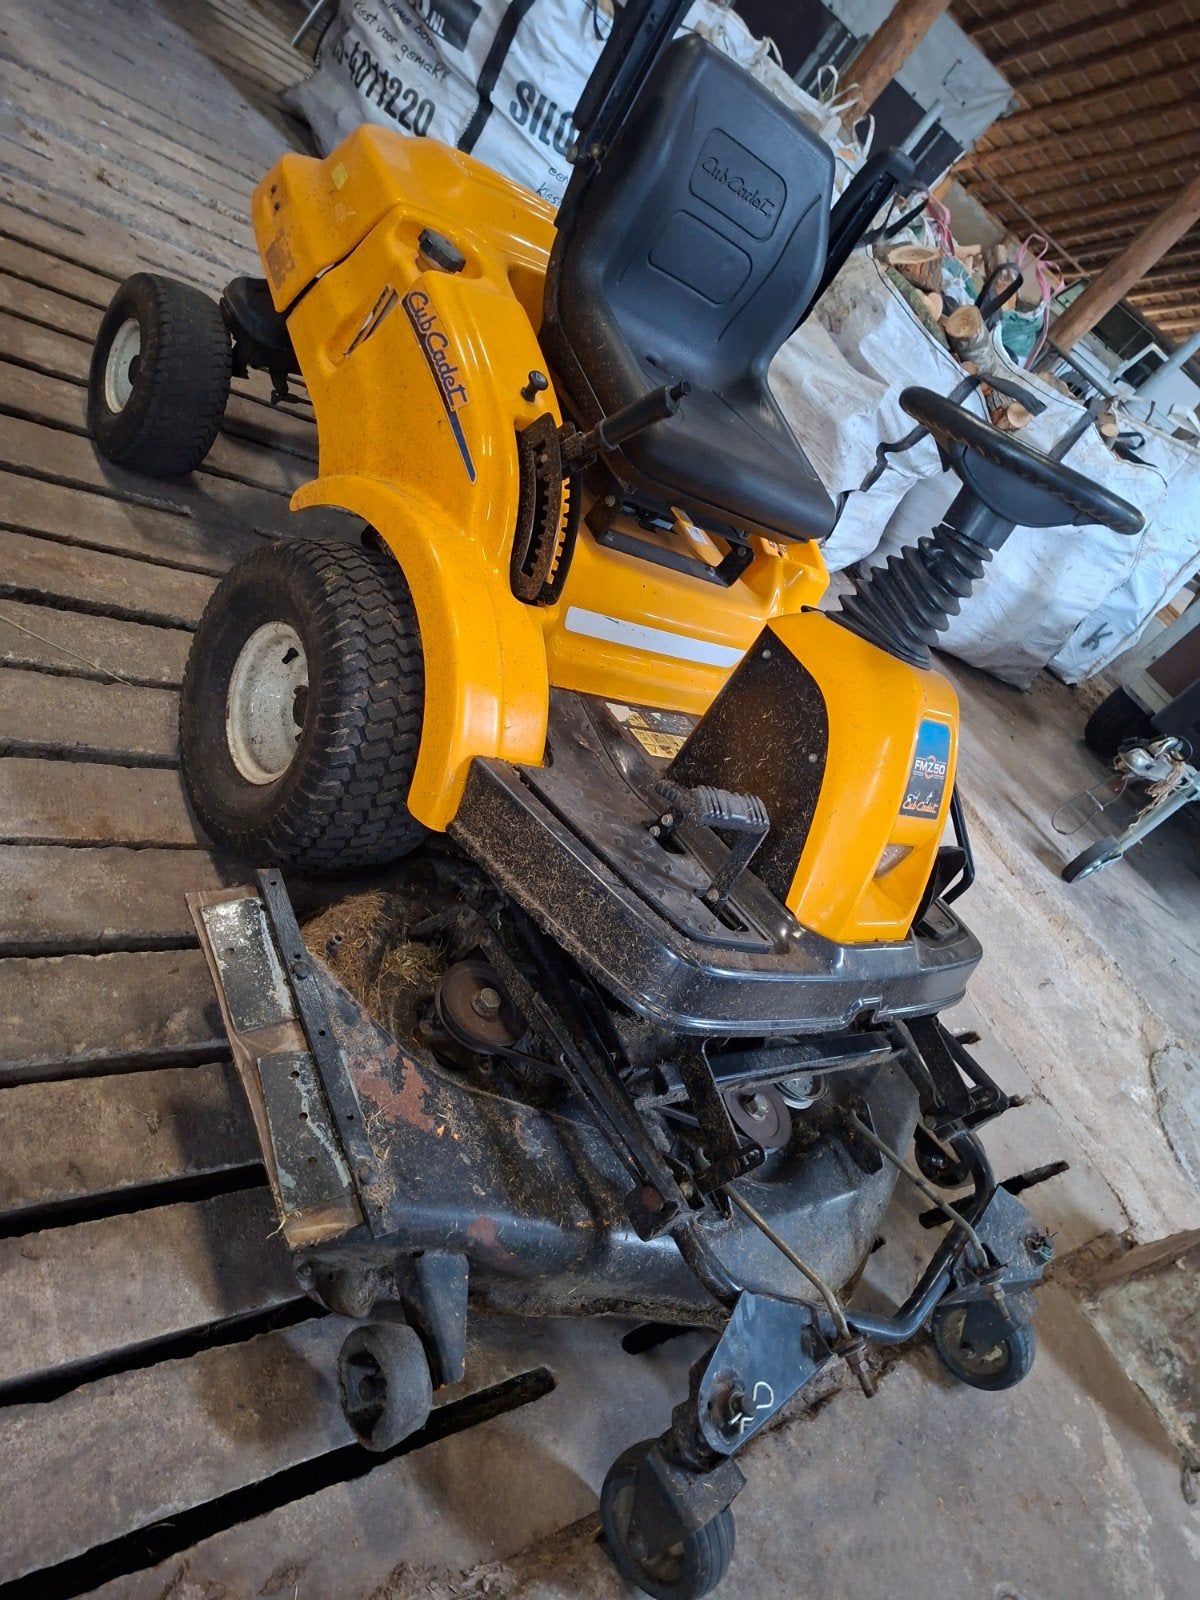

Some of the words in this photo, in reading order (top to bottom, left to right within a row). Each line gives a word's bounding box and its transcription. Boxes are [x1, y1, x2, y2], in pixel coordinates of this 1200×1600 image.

[376, 25, 397, 44] voor
[702, 156, 729, 184] Cub
[727, 176, 775, 216] Cadet
[407, 291, 437, 333] Cub
[425, 330, 468, 408] Cadet
[914, 760, 946, 775] FMZ50
